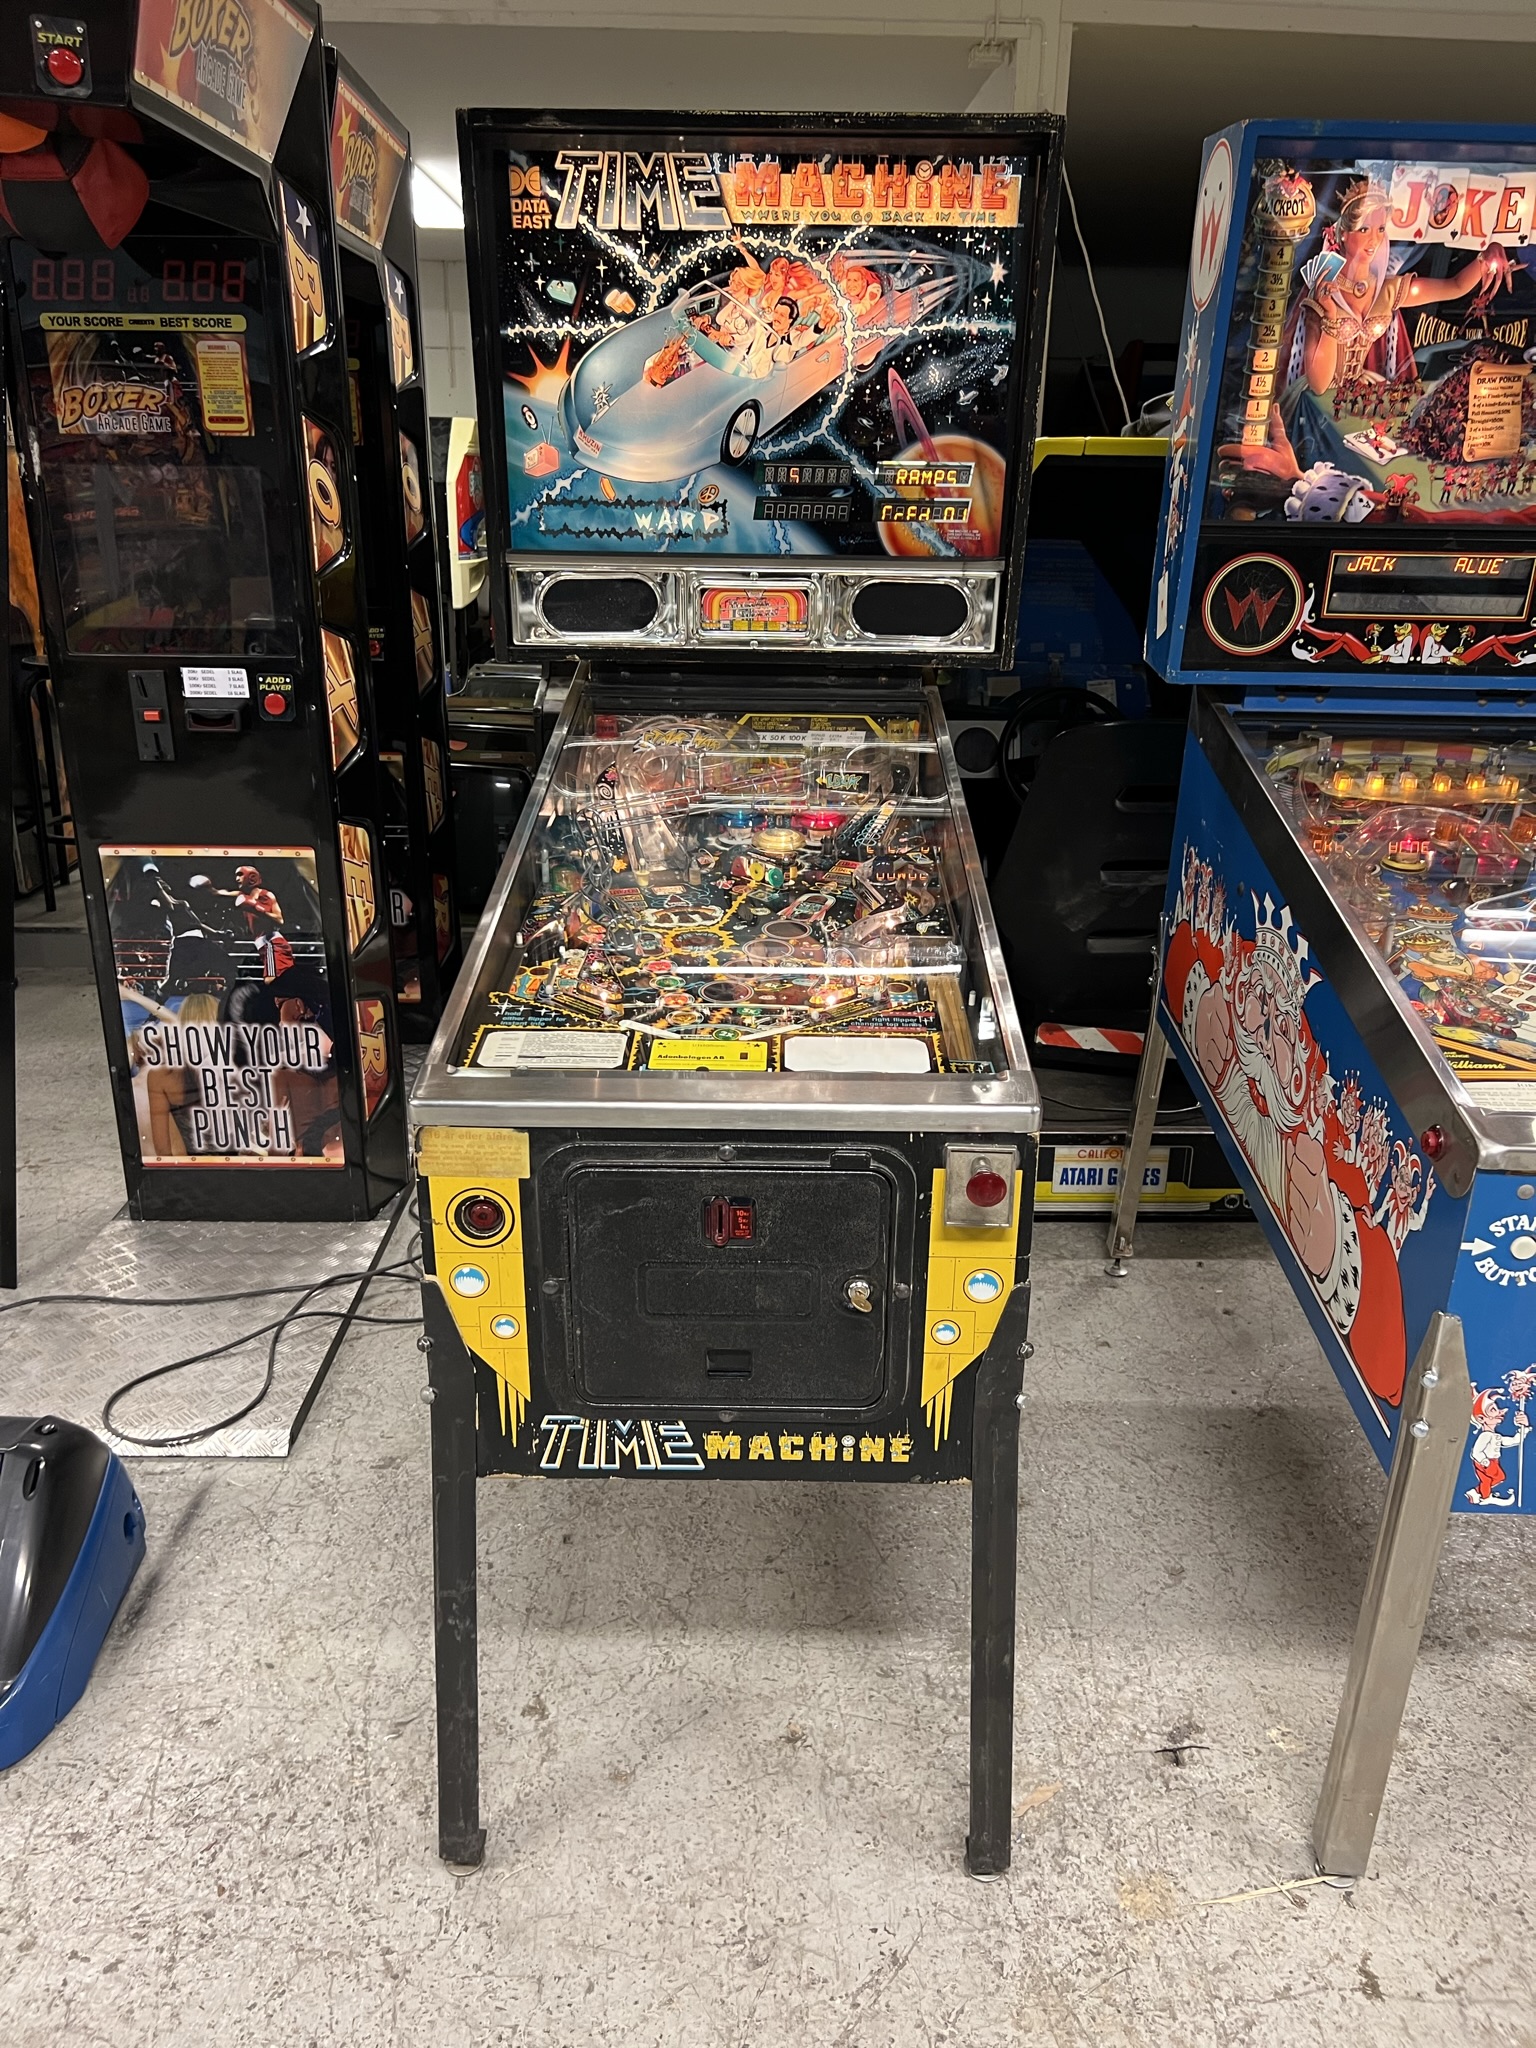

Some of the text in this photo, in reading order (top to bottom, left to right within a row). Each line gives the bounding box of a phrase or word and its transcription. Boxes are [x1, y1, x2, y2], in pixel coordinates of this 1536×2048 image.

[37, 32, 83, 47] START
[197, 46, 248, 110] ARCADE GAME
[340, 133, 377, 193] BOXER
[555, 151, 732, 231] TIME
[512, 199, 550, 213] DATA
[1261, 199, 1306, 216] JACKPOT
[1391, 181, 1536, 238] JOKE
[512, 215, 552, 229] EAST
[741, 210, 997, 223] WHERE YOU GO BACK IN TIME
[1276, 247, 1284, 259] 4
[1268, 299, 1275, 310] 3
[48, 316, 124, 327] YOUR SCORE
[160, 318, 233, 328] BEST SCORE
[1413, 312, 1529, 348] DOUBLE YOUR SCORE
[1262, 351, 1269, 362] 2
[1498, 375, 1522, 384] POKER
[61, 382, 168, 428] BOXER
[1255, 401, 1260, 412] 1
[97, 413, 172, 433] ARCADE GAME
[896, 468, 957, 485] RAMPS
[633, 506, 720, 531] WARP
[1347, 556, 1505, 574] JACK ALUE
[259, 683, 292, 691] PLAYER
[265, 676, 284, 684] ADD
[143, 1025, 323, 1068] SHOW YOUR
[202, 1068, 273, 1109] BEST
[194, 1109, 292, 1149] PUNCH
[457, 1130, 483, 1140] eller
[486, 1131, 514, 1141] äldre
[1059, 1168, 1161, 1186] ATARI GES
[540, 1414, 706, 1470] TIME
